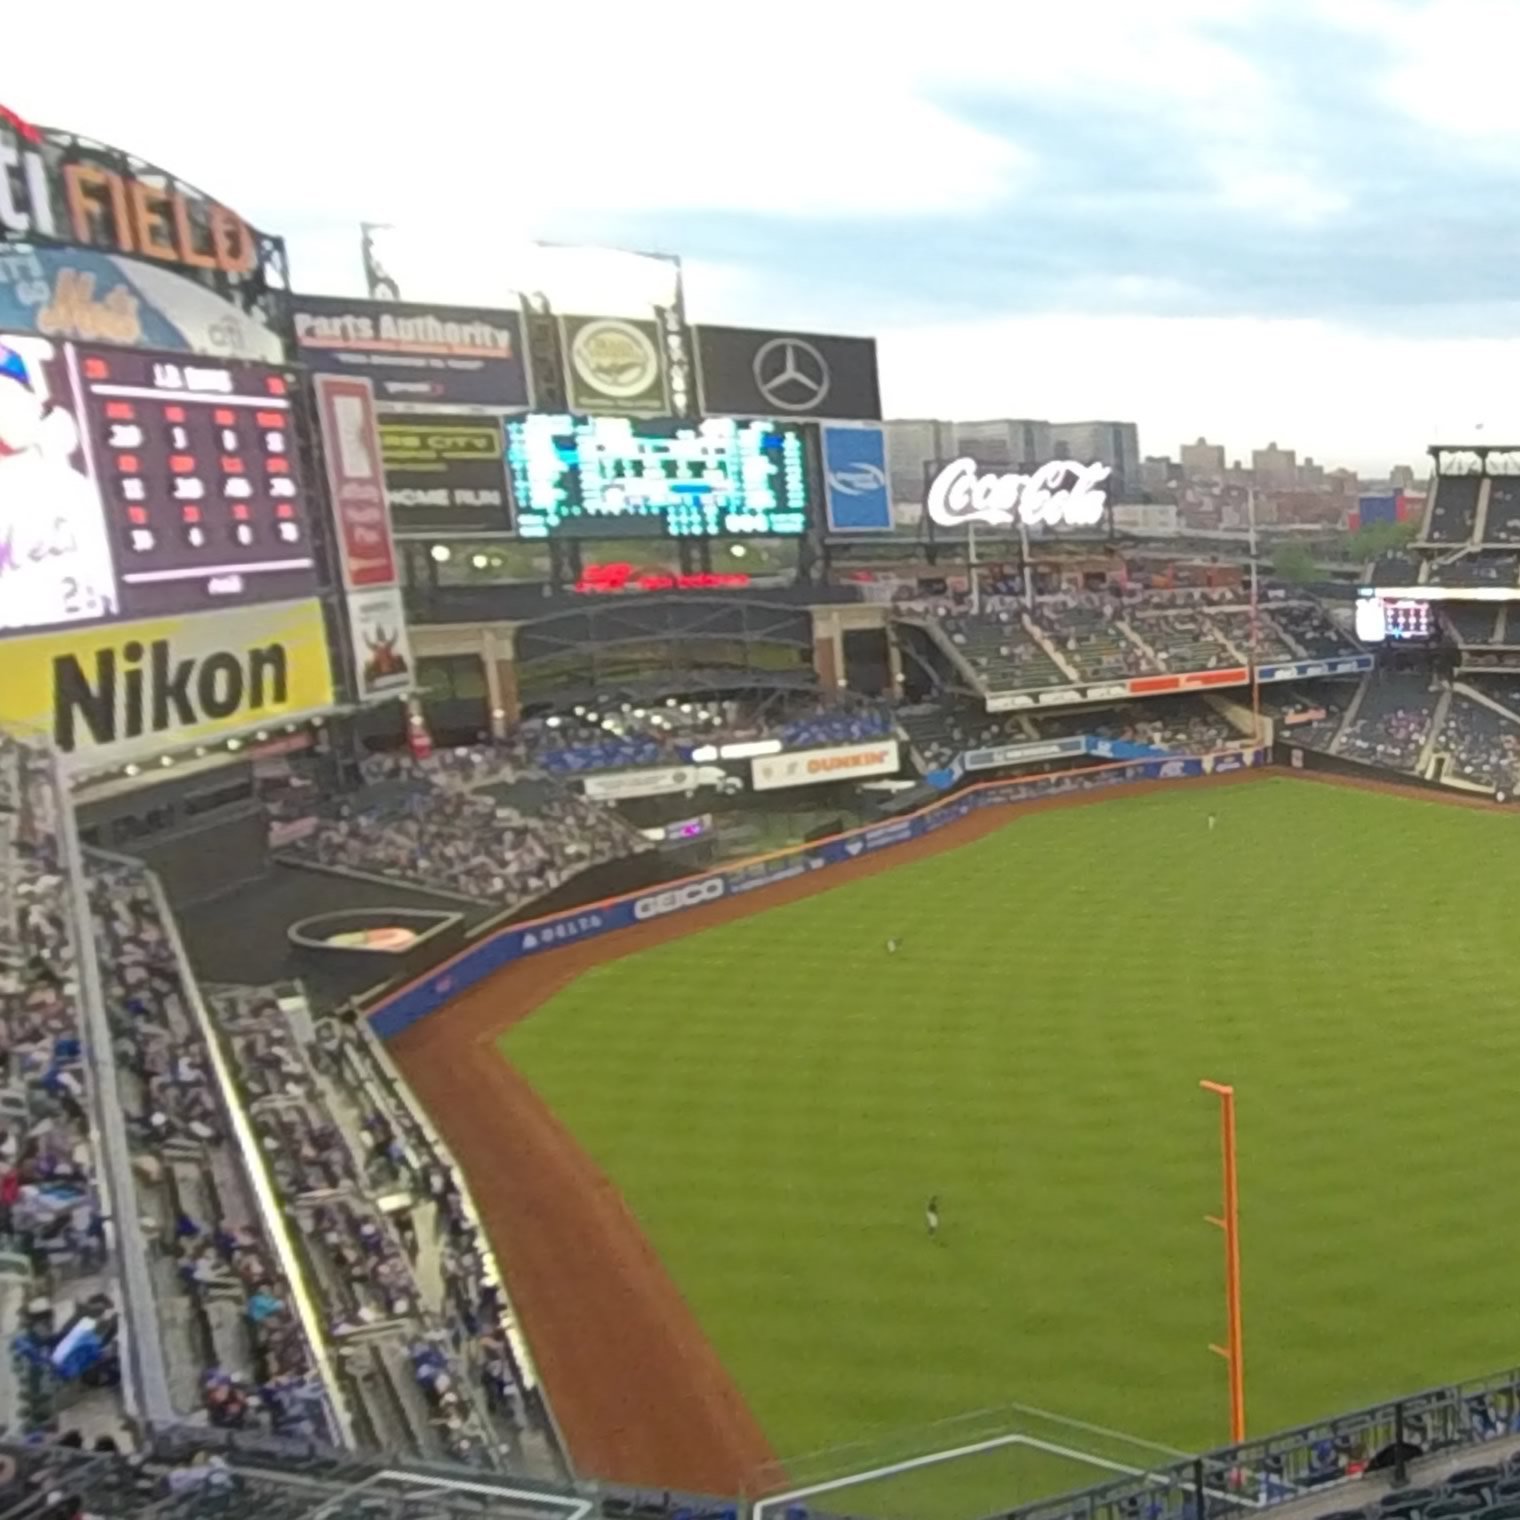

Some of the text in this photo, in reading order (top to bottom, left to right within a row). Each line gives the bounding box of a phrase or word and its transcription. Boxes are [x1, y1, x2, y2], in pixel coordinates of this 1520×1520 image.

[62, 163, 259, 272] FIELD
[293, 312, 512, 349] Parts Authority
[52, 640, 289, 753] Nikon
[633, 877, 725, 920] GEICO
